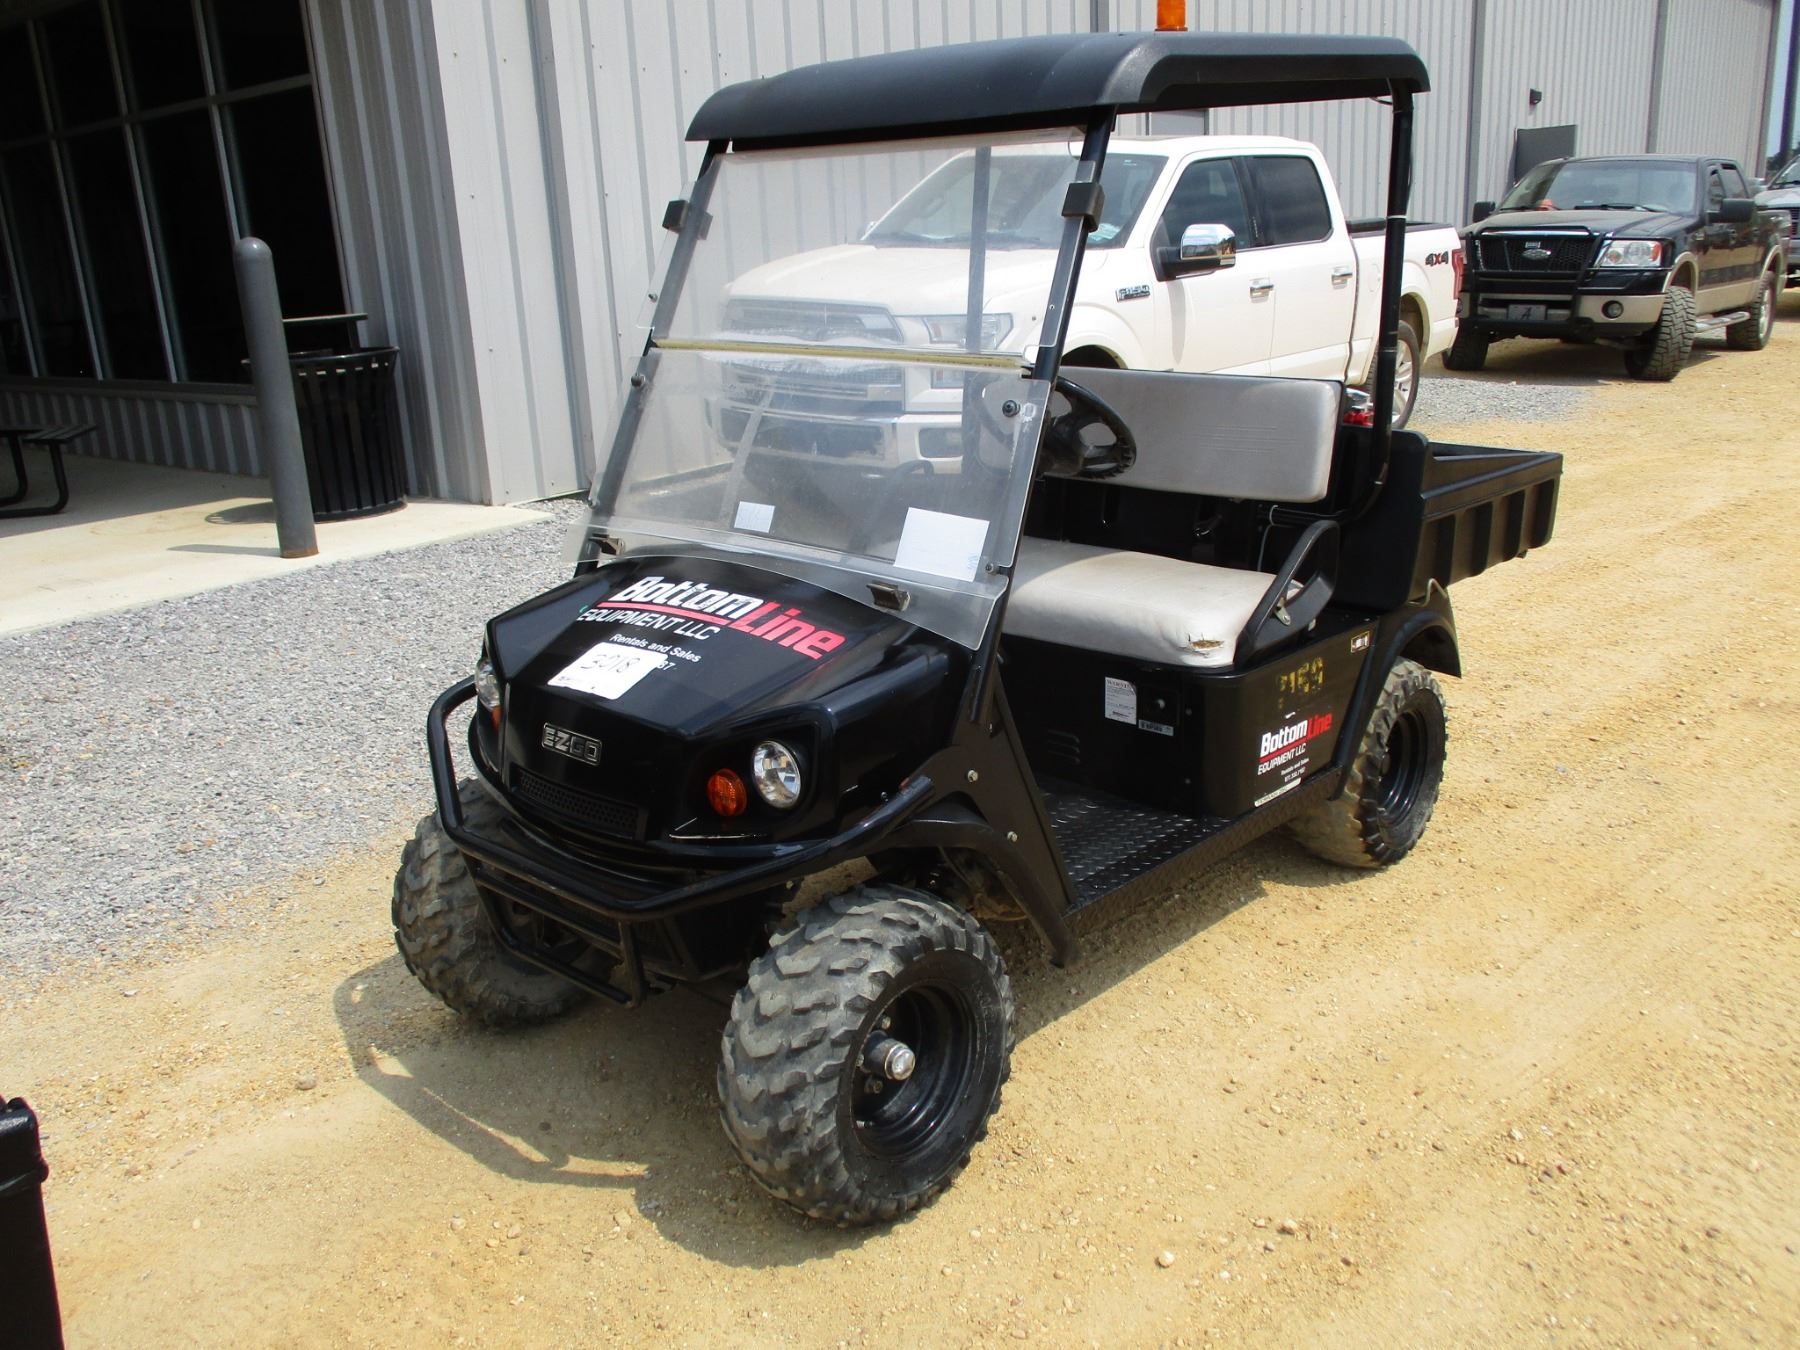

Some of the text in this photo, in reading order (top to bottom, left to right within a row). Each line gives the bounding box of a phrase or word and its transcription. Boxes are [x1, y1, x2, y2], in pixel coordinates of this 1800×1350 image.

[576, 608, 721, 640] EQUIPMENT LLC
[609, 633, 702, 663] Rentals and Sales
[1257, 748, 1296, 776] EQUIPMENT
[1294, 742, 1307, 757] LLC
